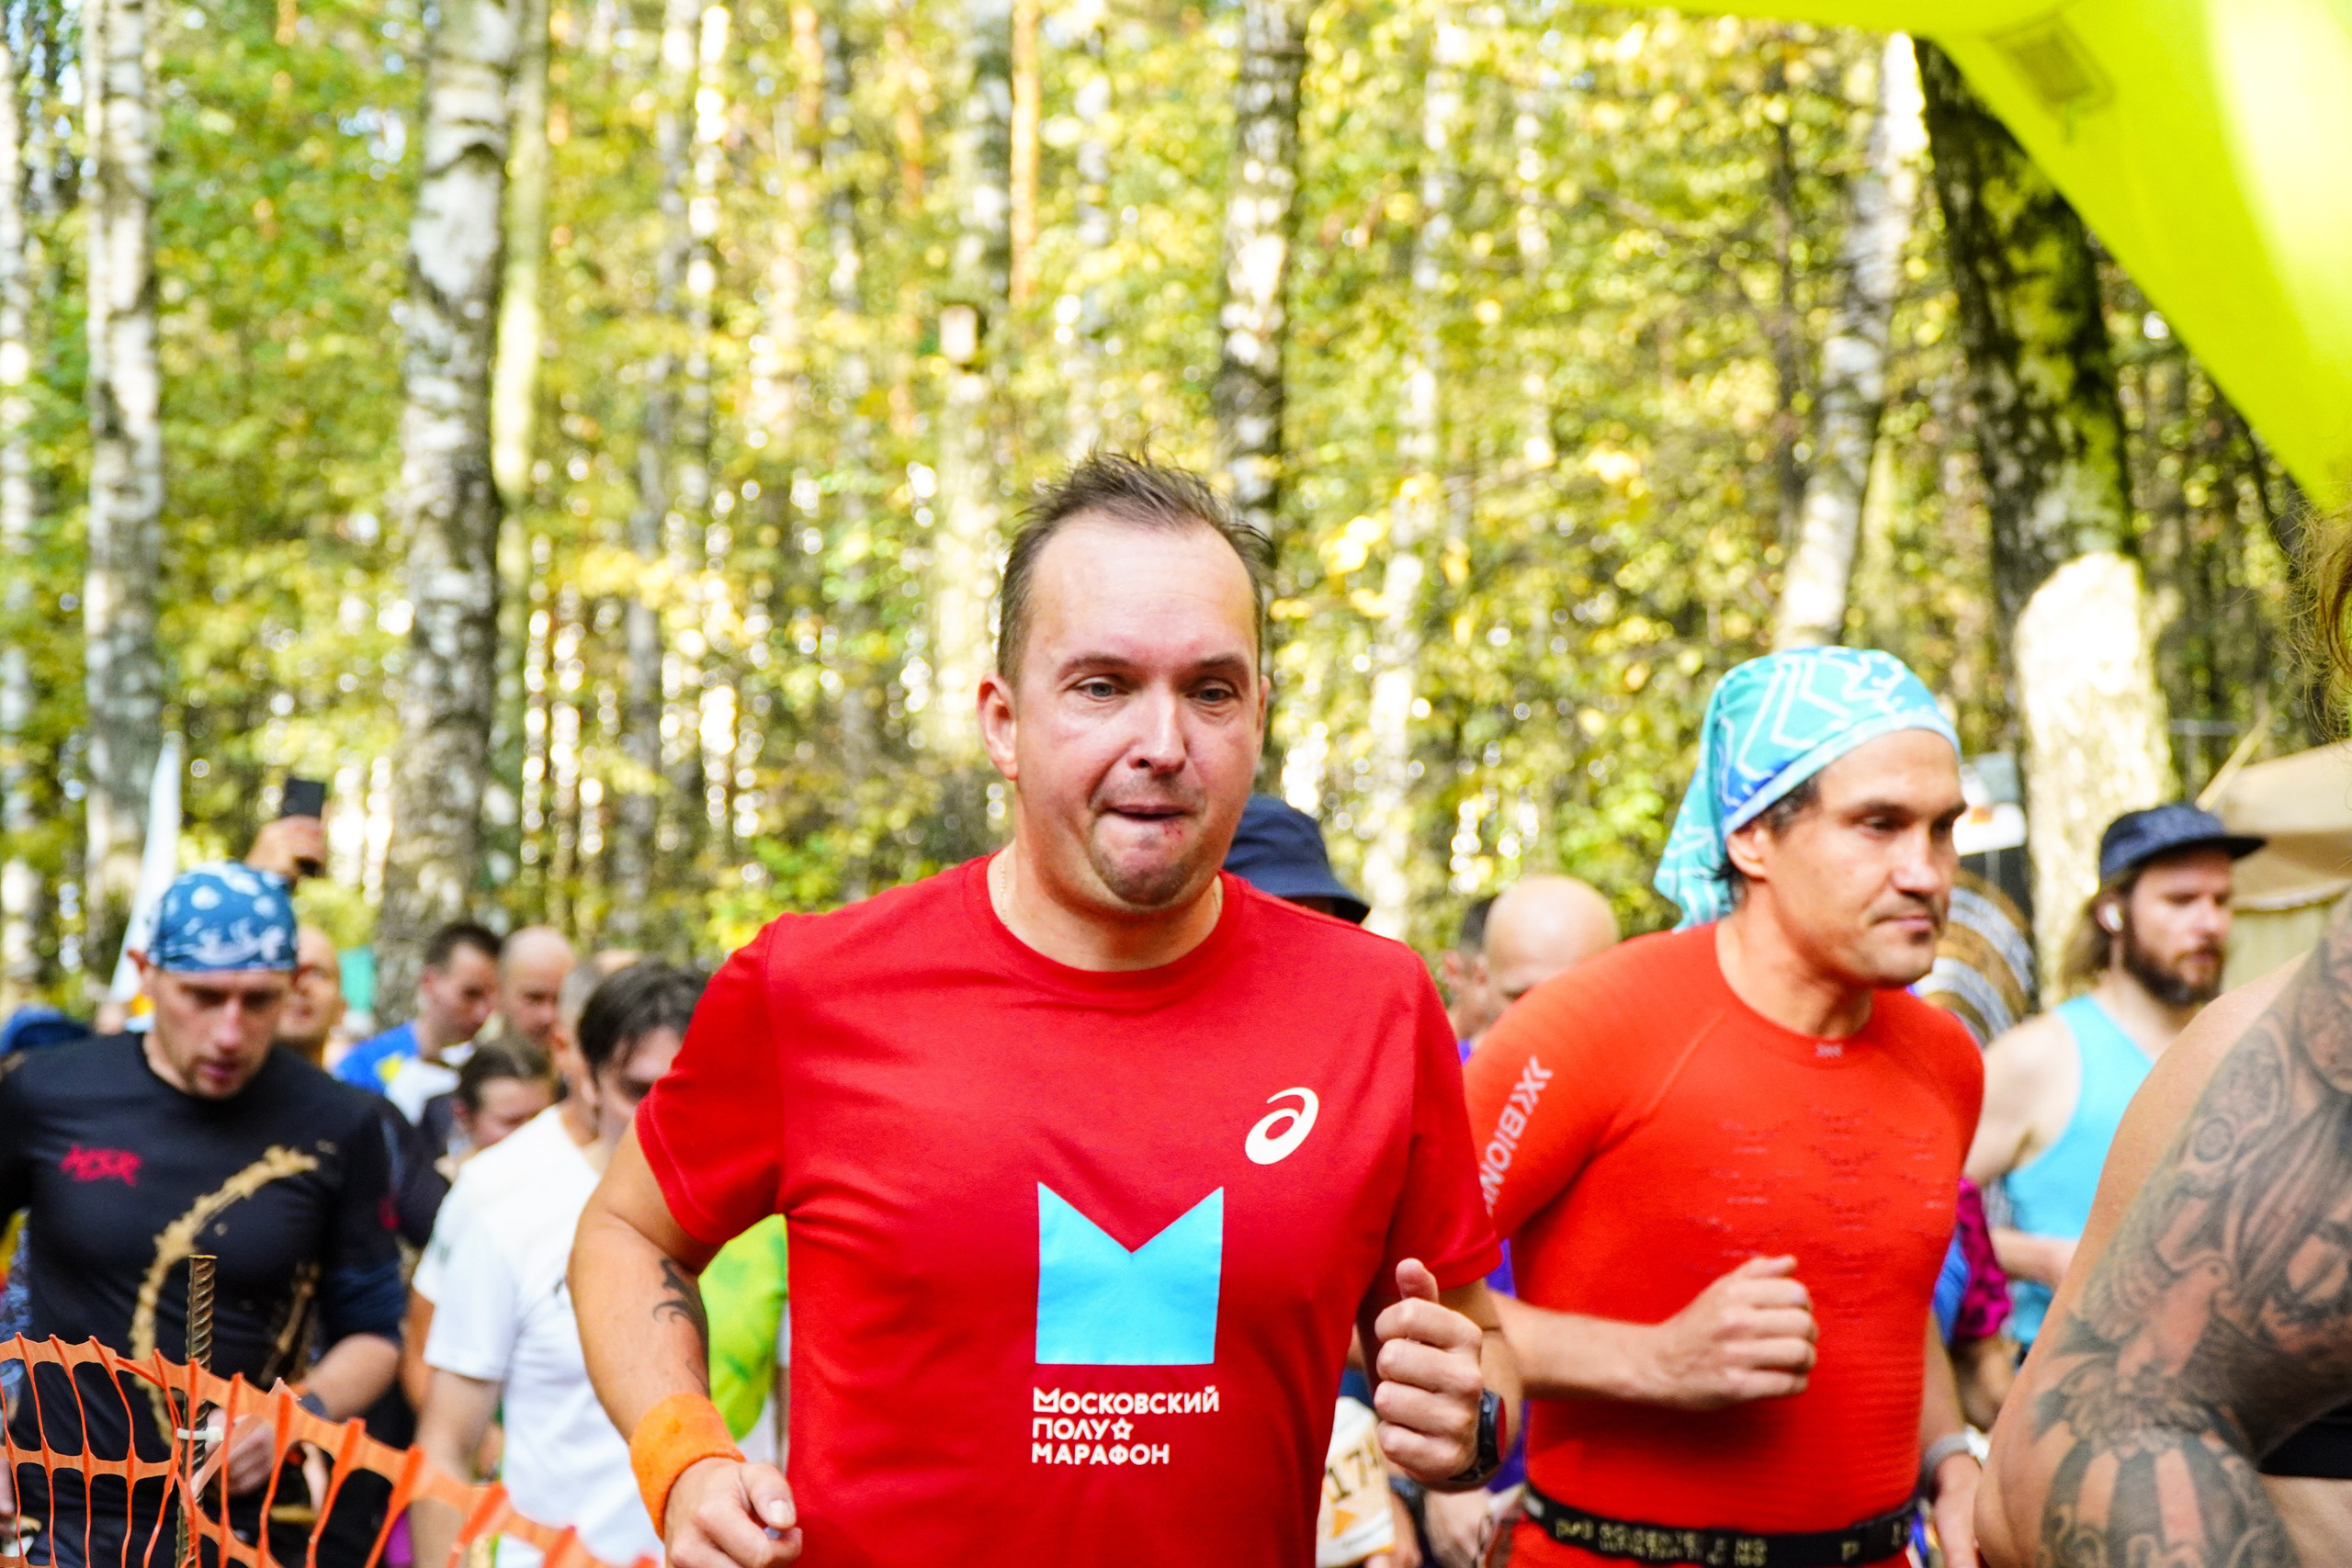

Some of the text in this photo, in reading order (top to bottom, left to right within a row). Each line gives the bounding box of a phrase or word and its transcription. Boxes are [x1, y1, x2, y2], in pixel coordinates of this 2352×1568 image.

[1032, 1384, 1220, 1415] МОСКОВСКИЙ
[1032, 1416, 1111, 1440] ПОЛУ
[1031, 1441, 1170, 1466] МАРАФОН
